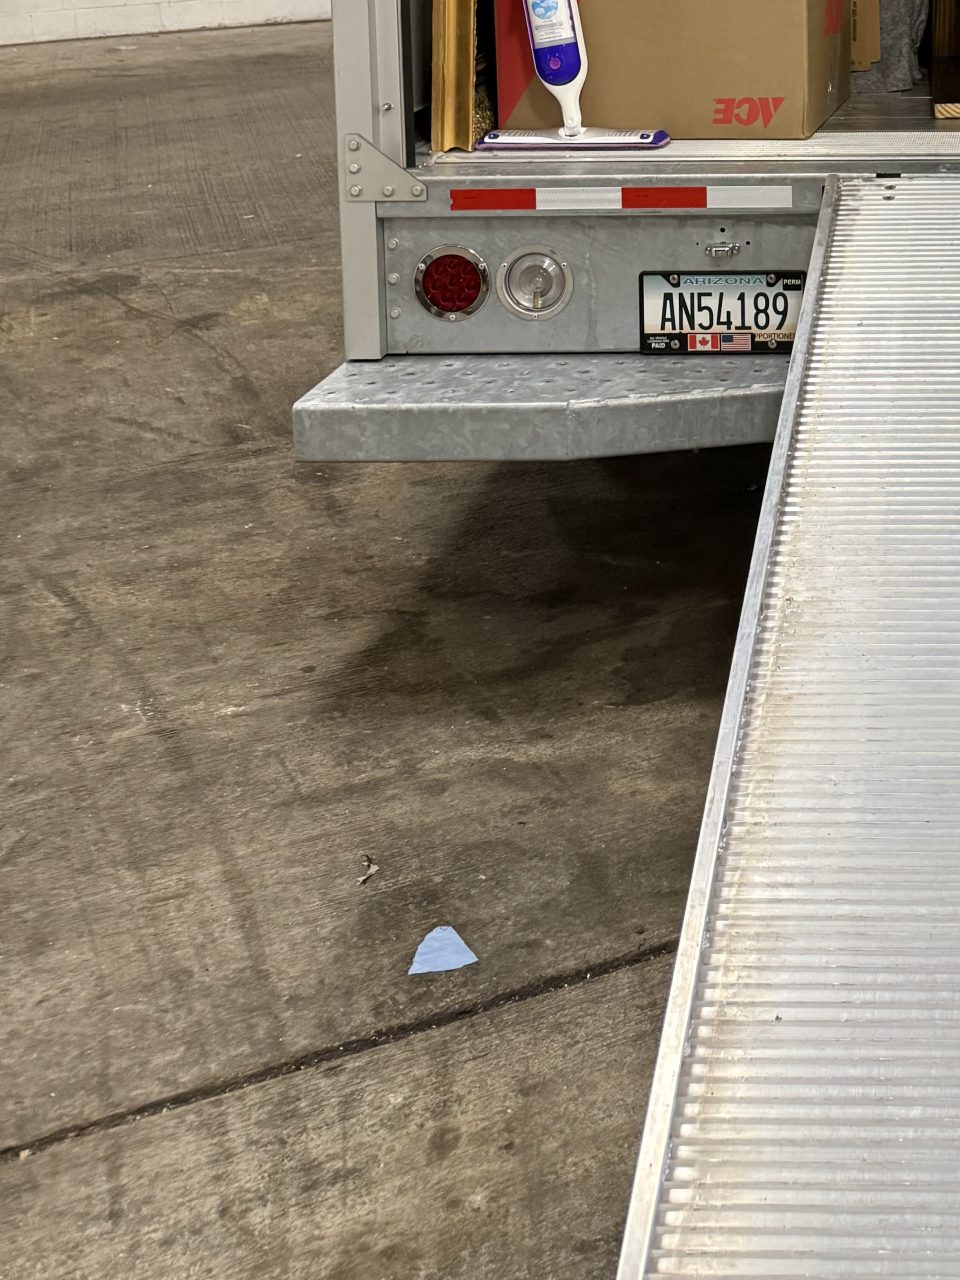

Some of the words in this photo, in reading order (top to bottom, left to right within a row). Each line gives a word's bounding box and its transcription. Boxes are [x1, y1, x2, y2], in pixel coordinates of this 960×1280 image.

[712, 96, 786, 128] ACE
[683, 276, 764, 286] ARIZONA
[660, 292, 789, 331] AN54189
